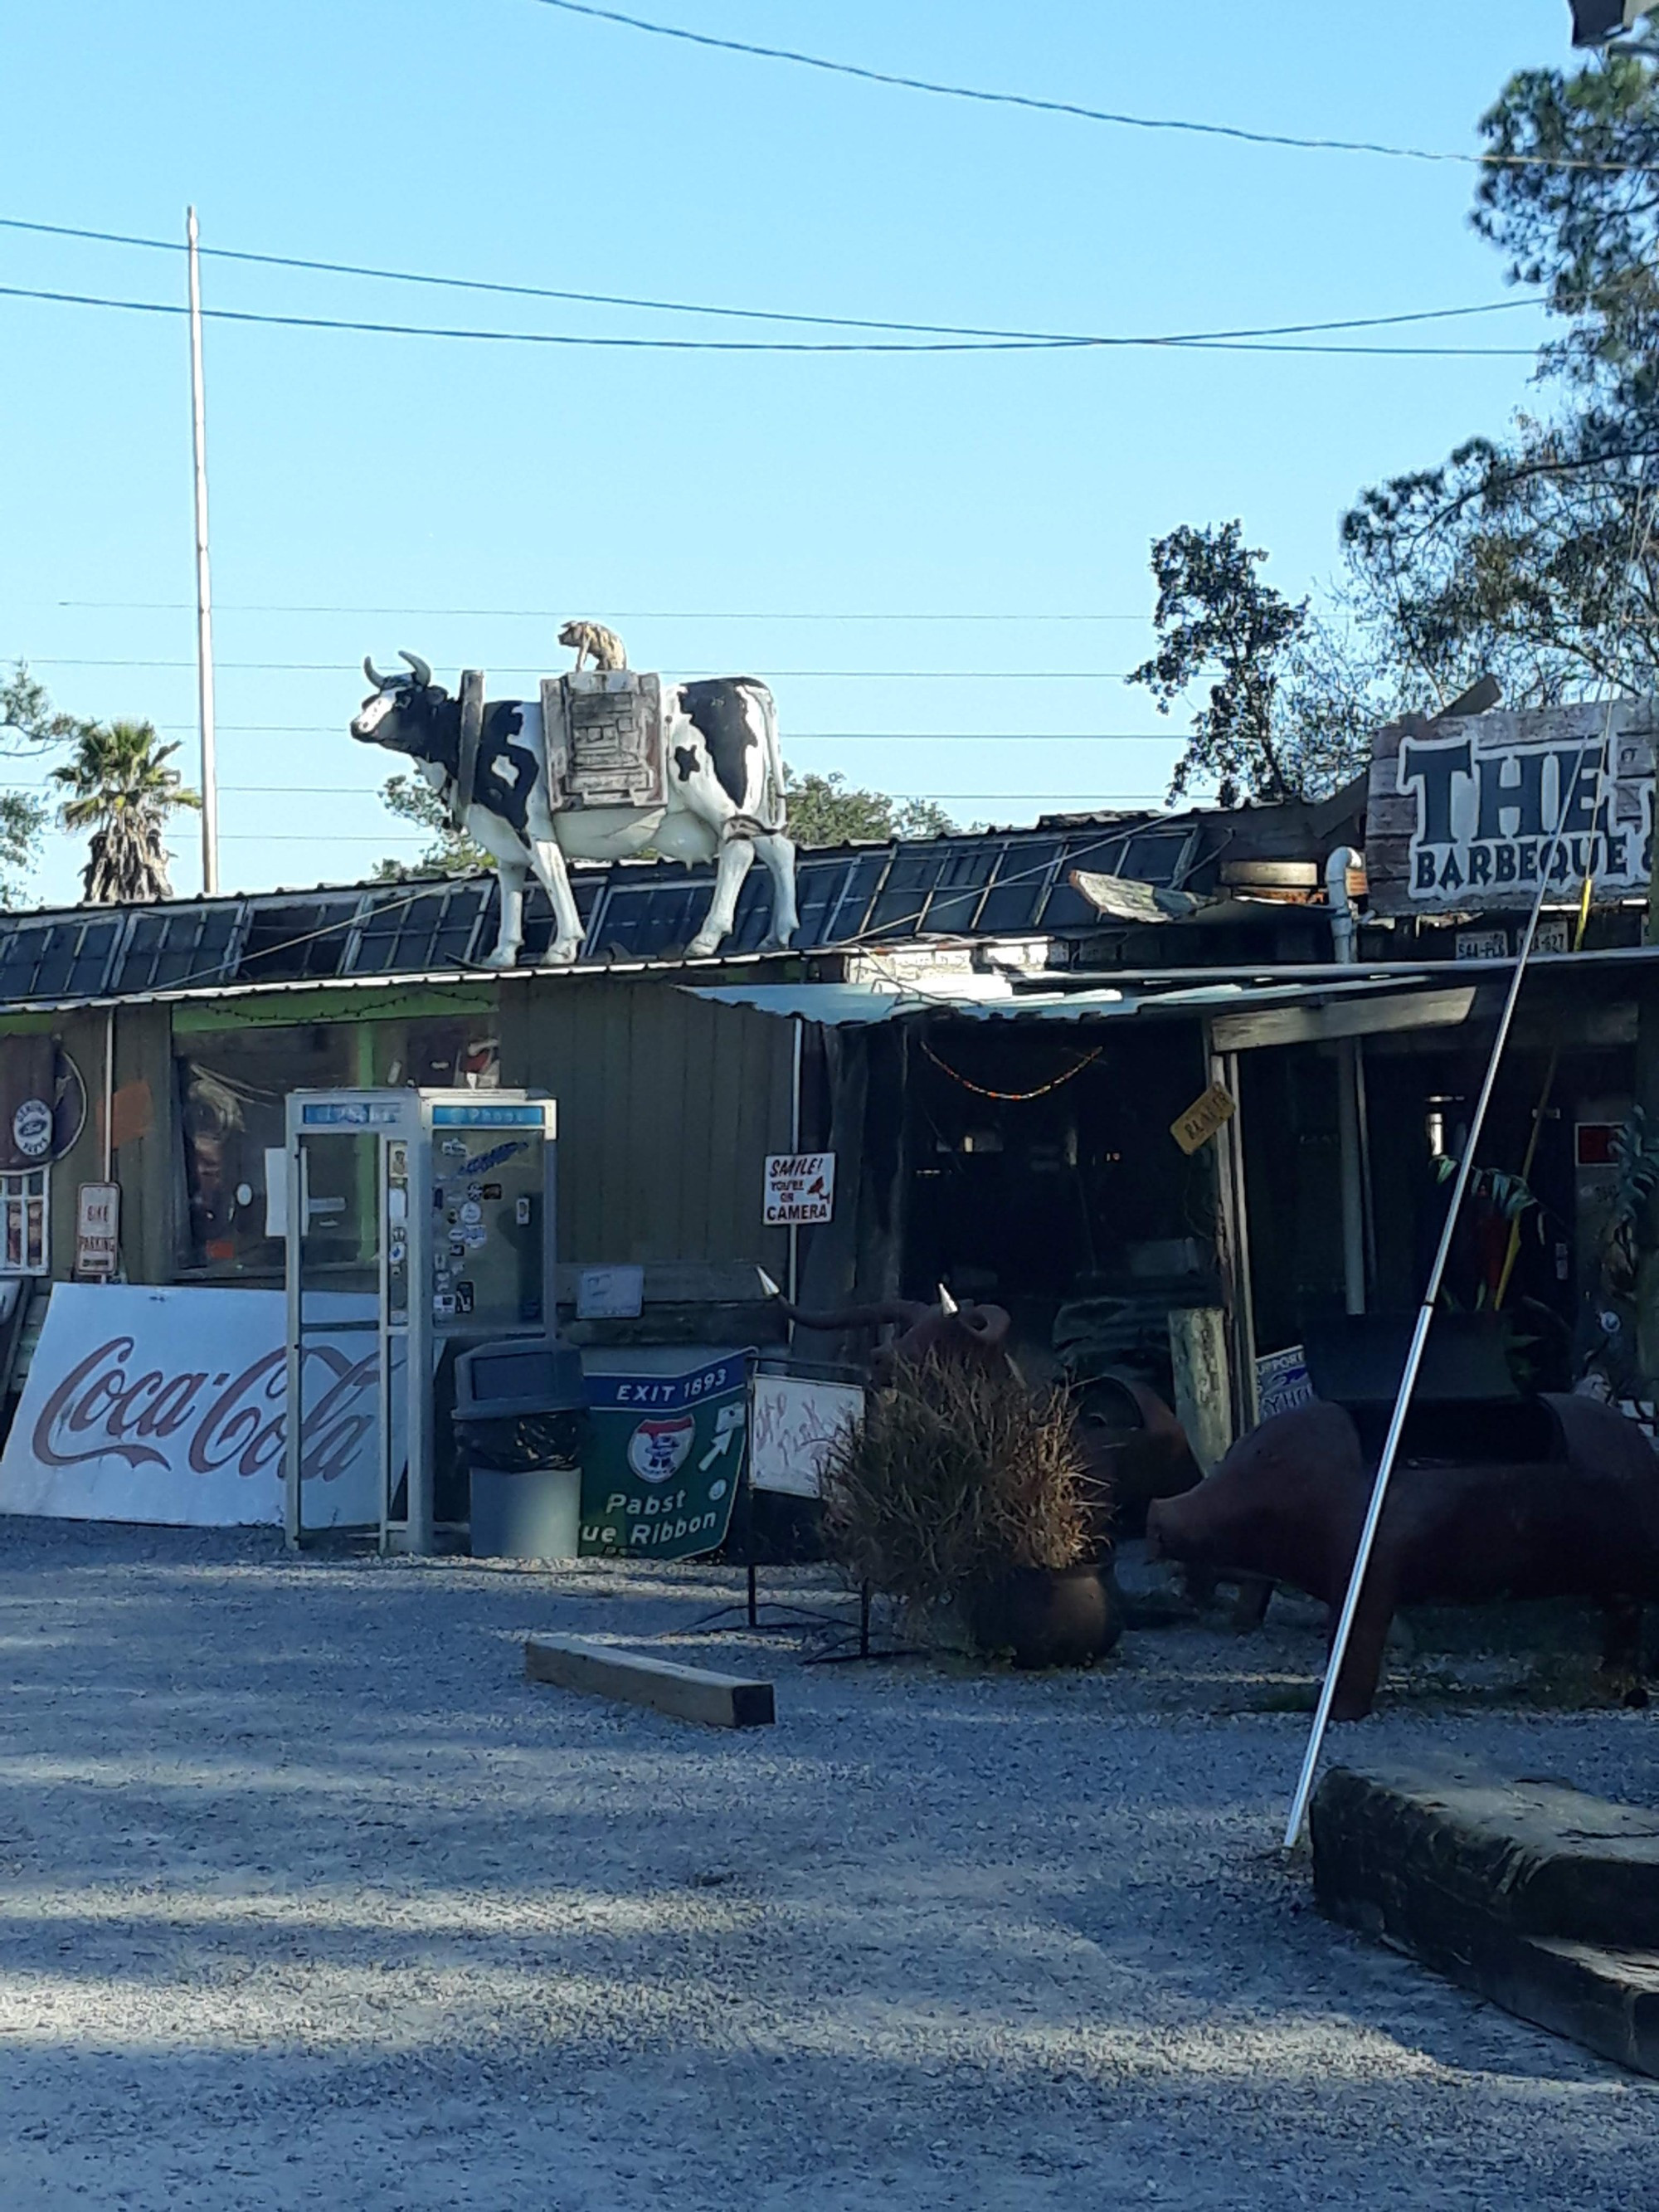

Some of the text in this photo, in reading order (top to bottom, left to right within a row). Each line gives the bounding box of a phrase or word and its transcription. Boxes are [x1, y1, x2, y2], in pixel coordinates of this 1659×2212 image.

[1404, 742, 1609, 846] THE
[1415, 834, 1628, 890] BARBEQUE
[769, 1157, 823, 1177] SMILE!
[766, 1204, 828, 1220] CAMERA
[79, 1236, 114, 1252] PARKING
[615, 1368, 727, 1402] EXIT 1893
[32, 1336, 393, 1483] Coca-Cola
[606, 1489, 687, 1515] Pabst
[630, 1512, 718, 1546] Ribbon
